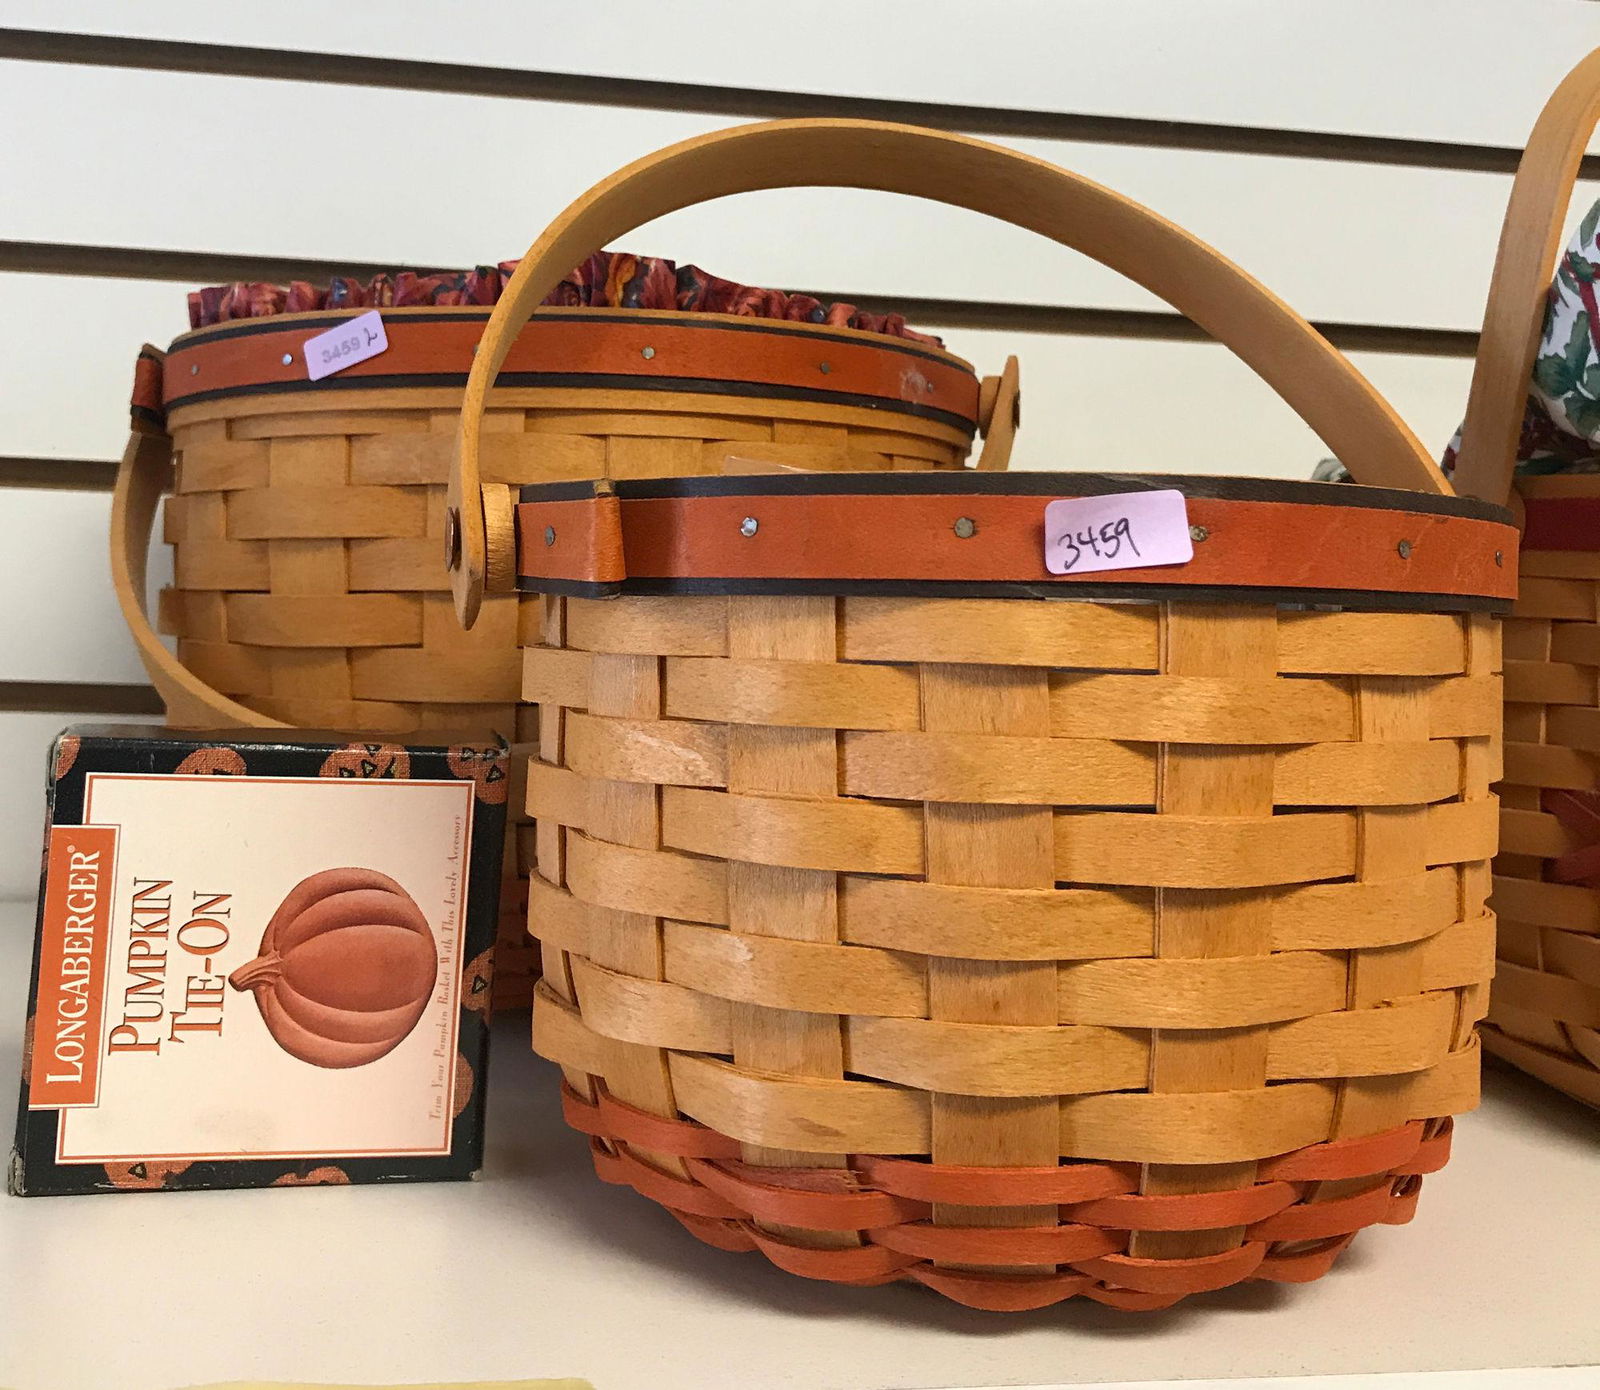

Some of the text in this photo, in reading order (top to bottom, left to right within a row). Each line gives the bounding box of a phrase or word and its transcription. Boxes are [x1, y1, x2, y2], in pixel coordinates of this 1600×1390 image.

[1057, 517, 1141, 570] 3459
[107, 876, 173, 1056] PUMPKIN
[168, 890, 232, 1043] TIE-ON
[429, 814, 461, 1120] Trim Your Pumpkin Basket With This Lovely Accessory
